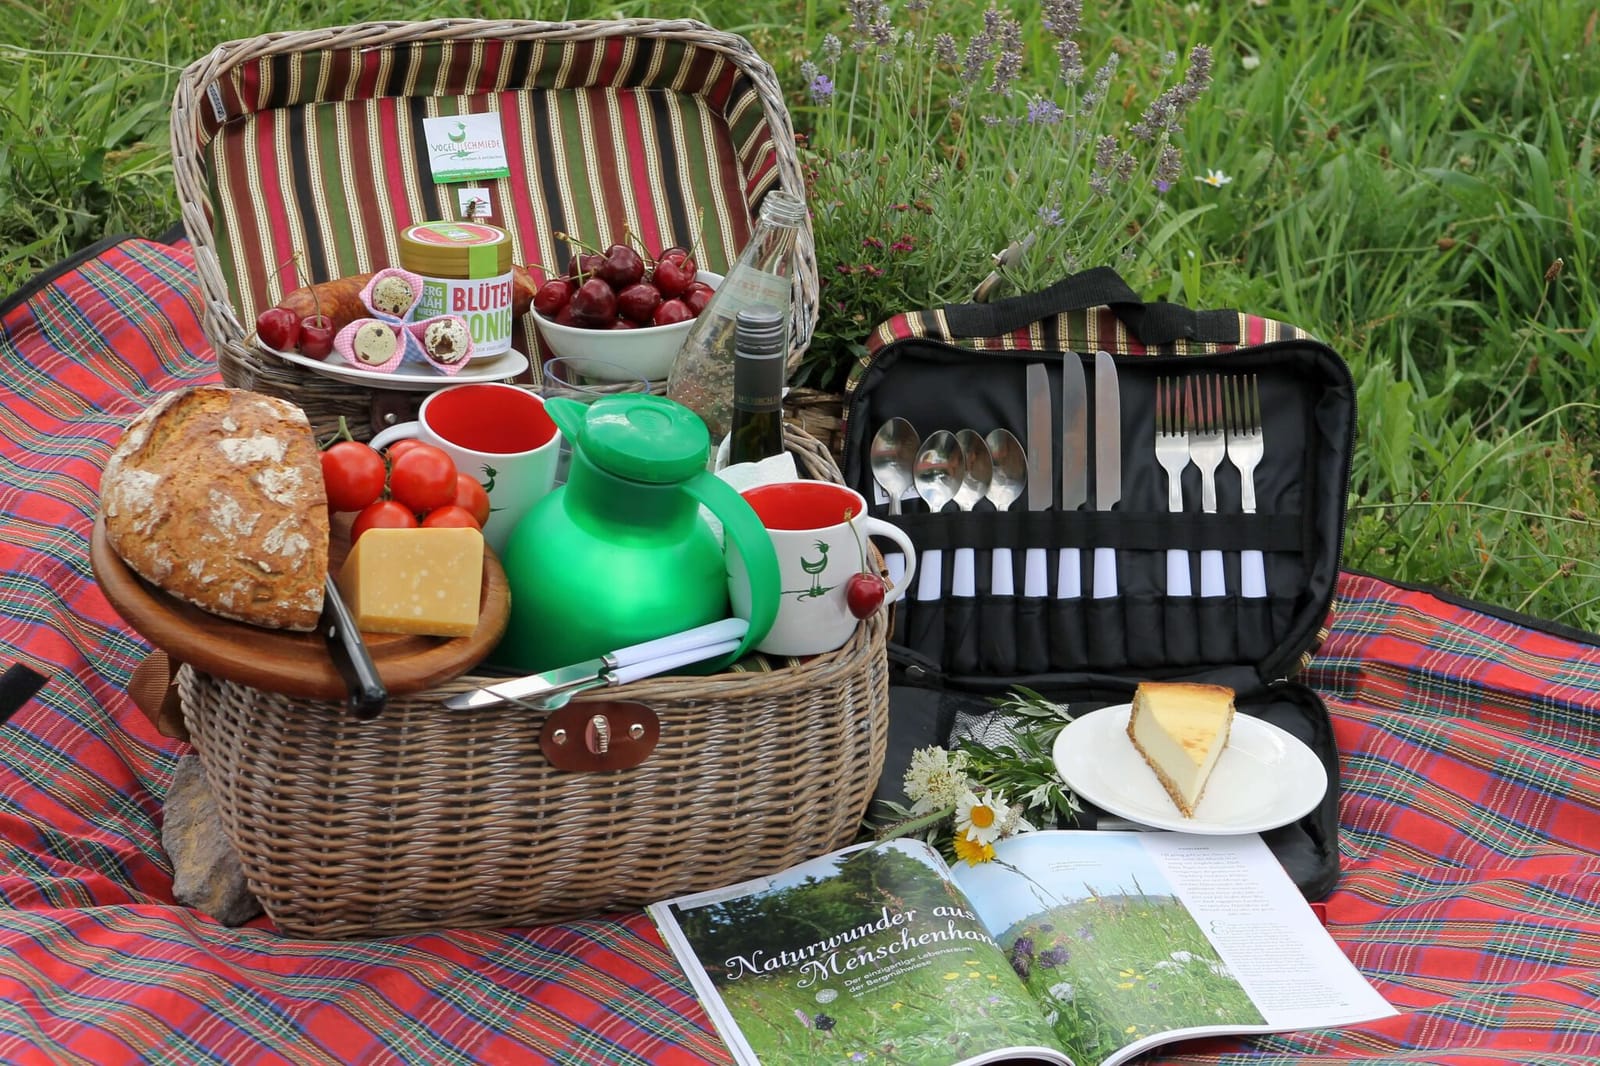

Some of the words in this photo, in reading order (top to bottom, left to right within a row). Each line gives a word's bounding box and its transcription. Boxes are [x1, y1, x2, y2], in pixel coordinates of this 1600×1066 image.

[431, 143, 457, 152] VOGEL
[464, 139, 500, 151] SCHMIEDE
[423, 286, 442, 297] ERG
[452, 281, 512, 312] BLÜTEN
[463, 307, 511, 344] ONIG
[725, 906, 917, 980] Naturwunder
[932, 905, 976, 921] aus
[844, 976, 862, 987] Der
[864, 957, 916, 979] einzigartige
[849, 983, 865, 993] der
[866, 961, 932, 986] Bergmähwiese
